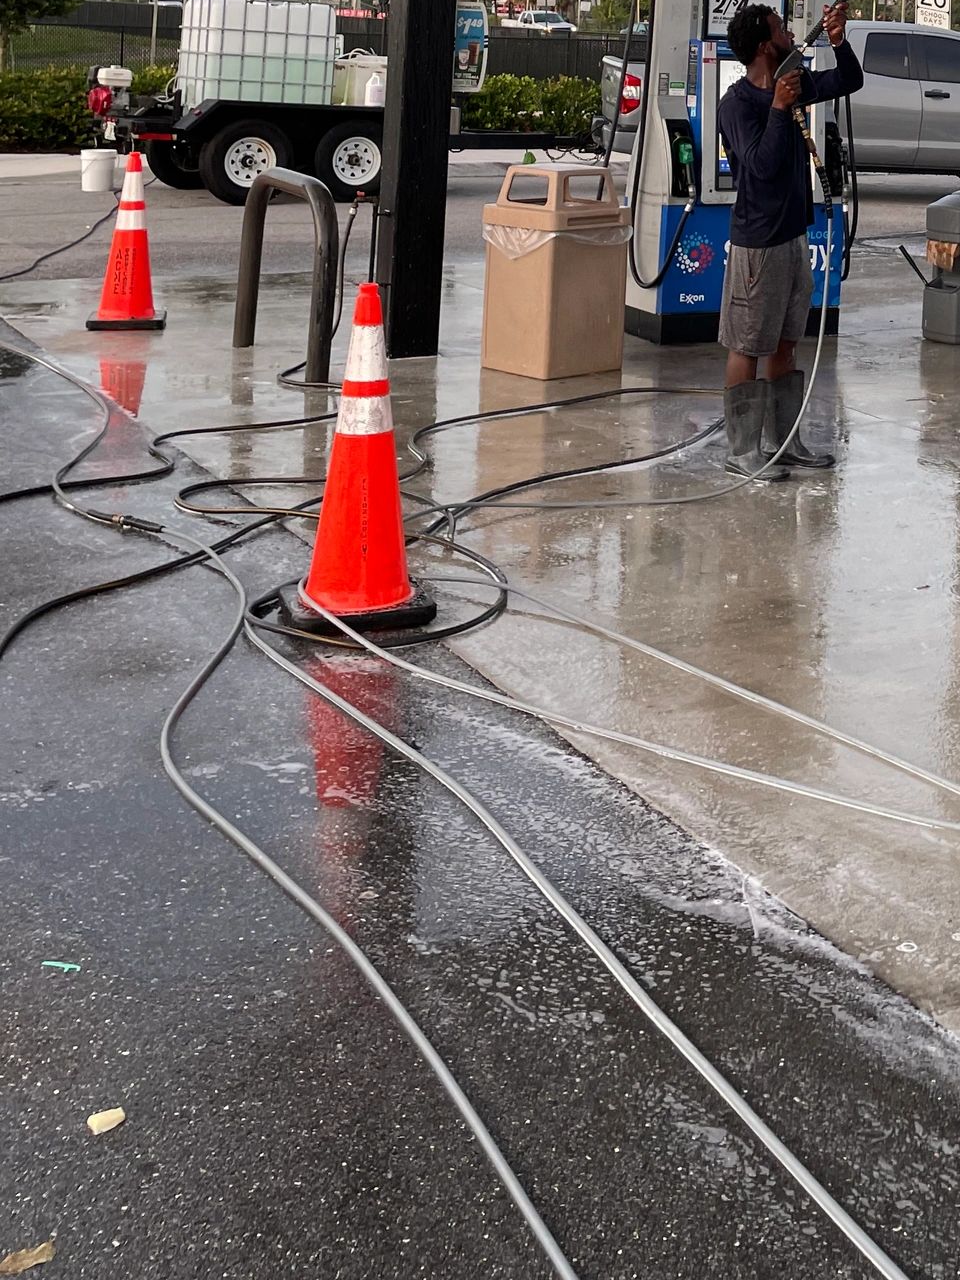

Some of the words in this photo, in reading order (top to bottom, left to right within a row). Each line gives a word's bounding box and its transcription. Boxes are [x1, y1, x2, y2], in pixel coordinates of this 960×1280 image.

[920, 10, 946, 20] SCHOOL
[923, 17, 943, 25] DAYS
[679, 293, 704, 304] Exxon
